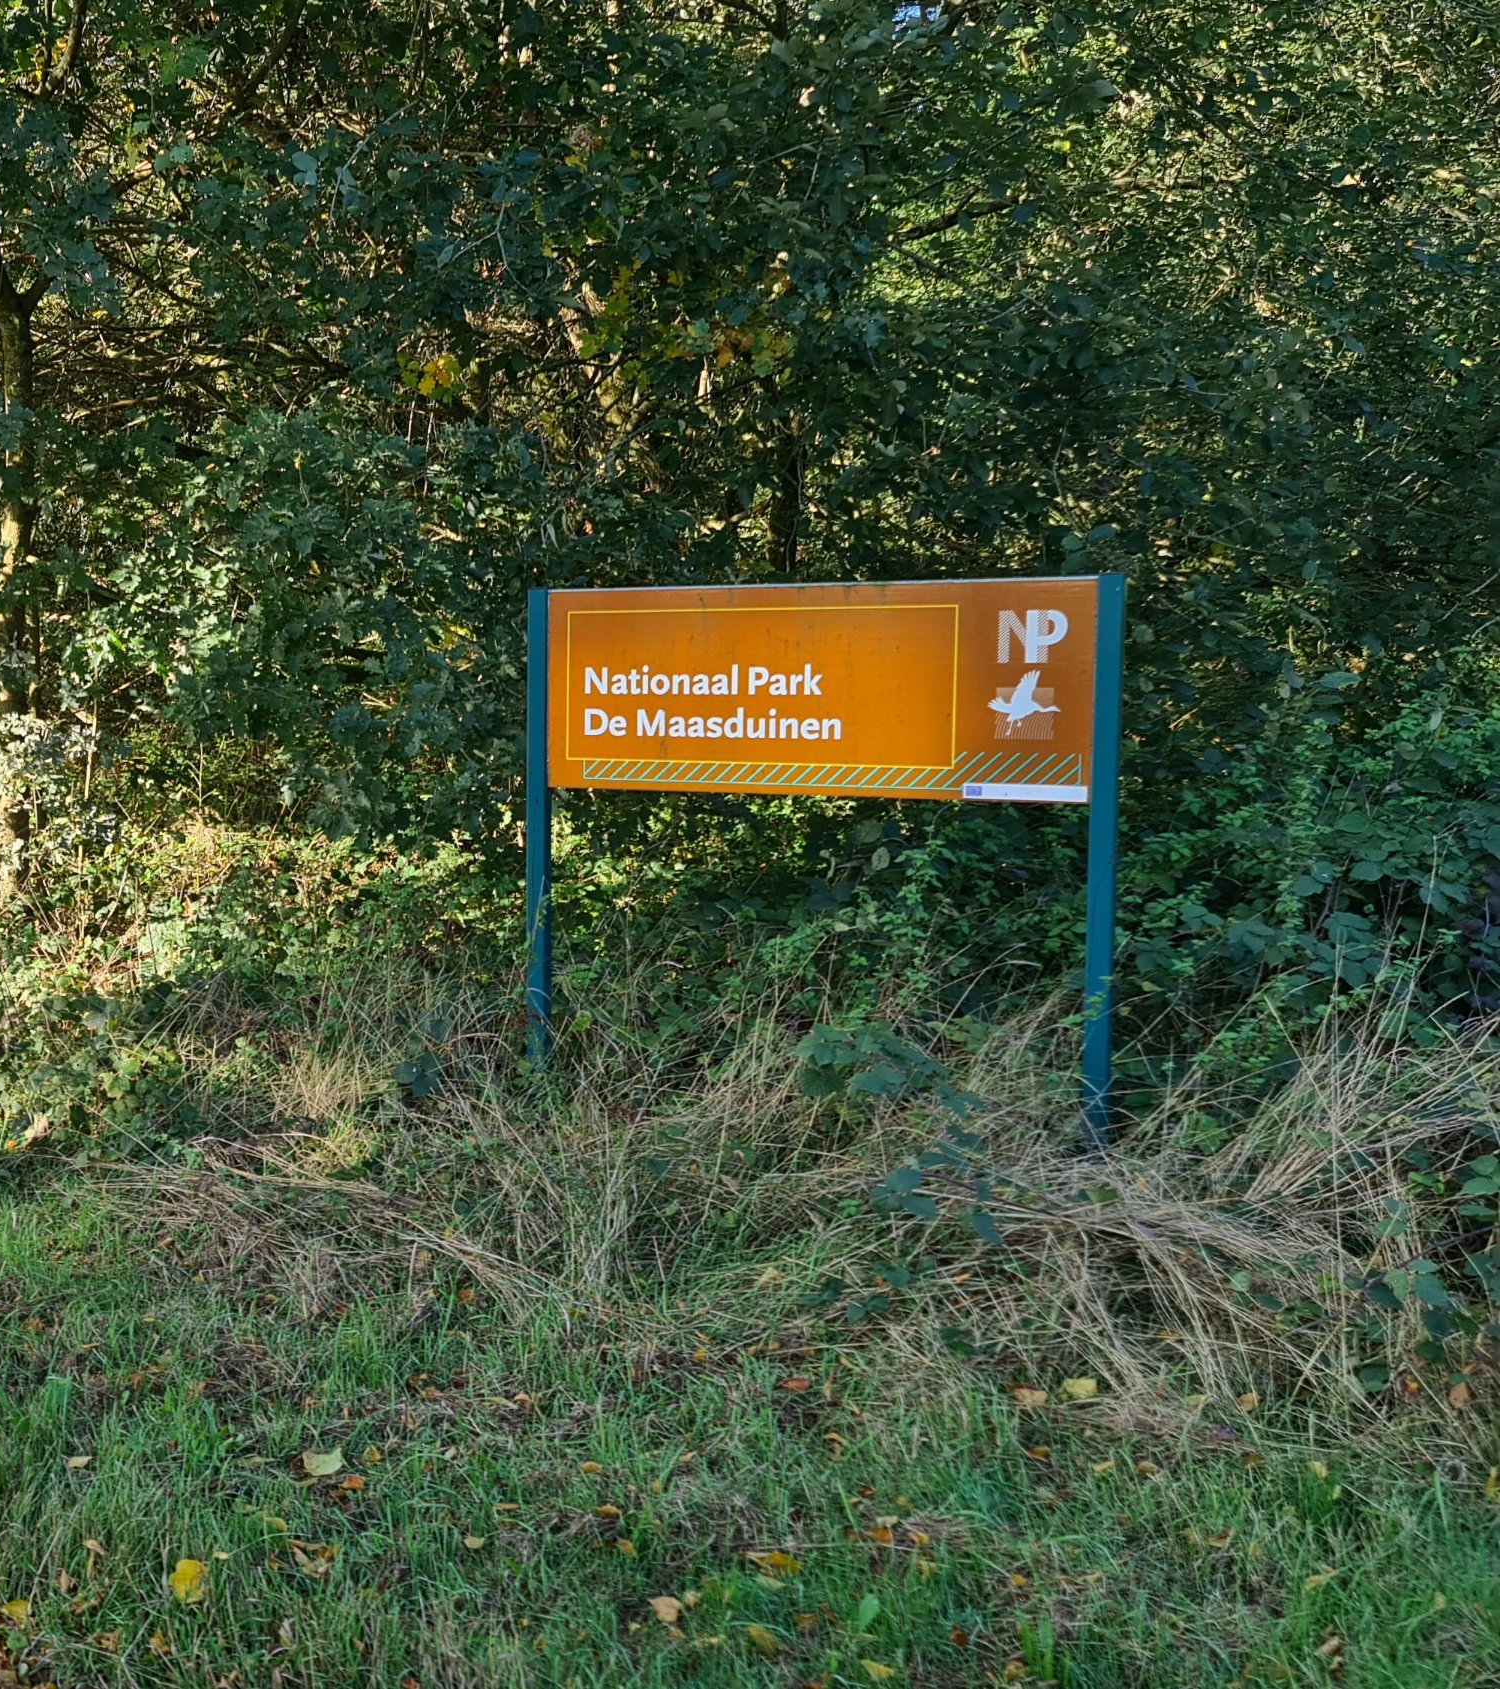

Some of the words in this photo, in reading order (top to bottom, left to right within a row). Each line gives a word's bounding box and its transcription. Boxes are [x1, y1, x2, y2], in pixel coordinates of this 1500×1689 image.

[997, 609, 1069, 664] NP
[584, 664, 739, 696] Nationaal
[748, 663, 823, 696] Park
[584, 708, 627, 737] De
[636, 707, 842, 740] Maasduinen
